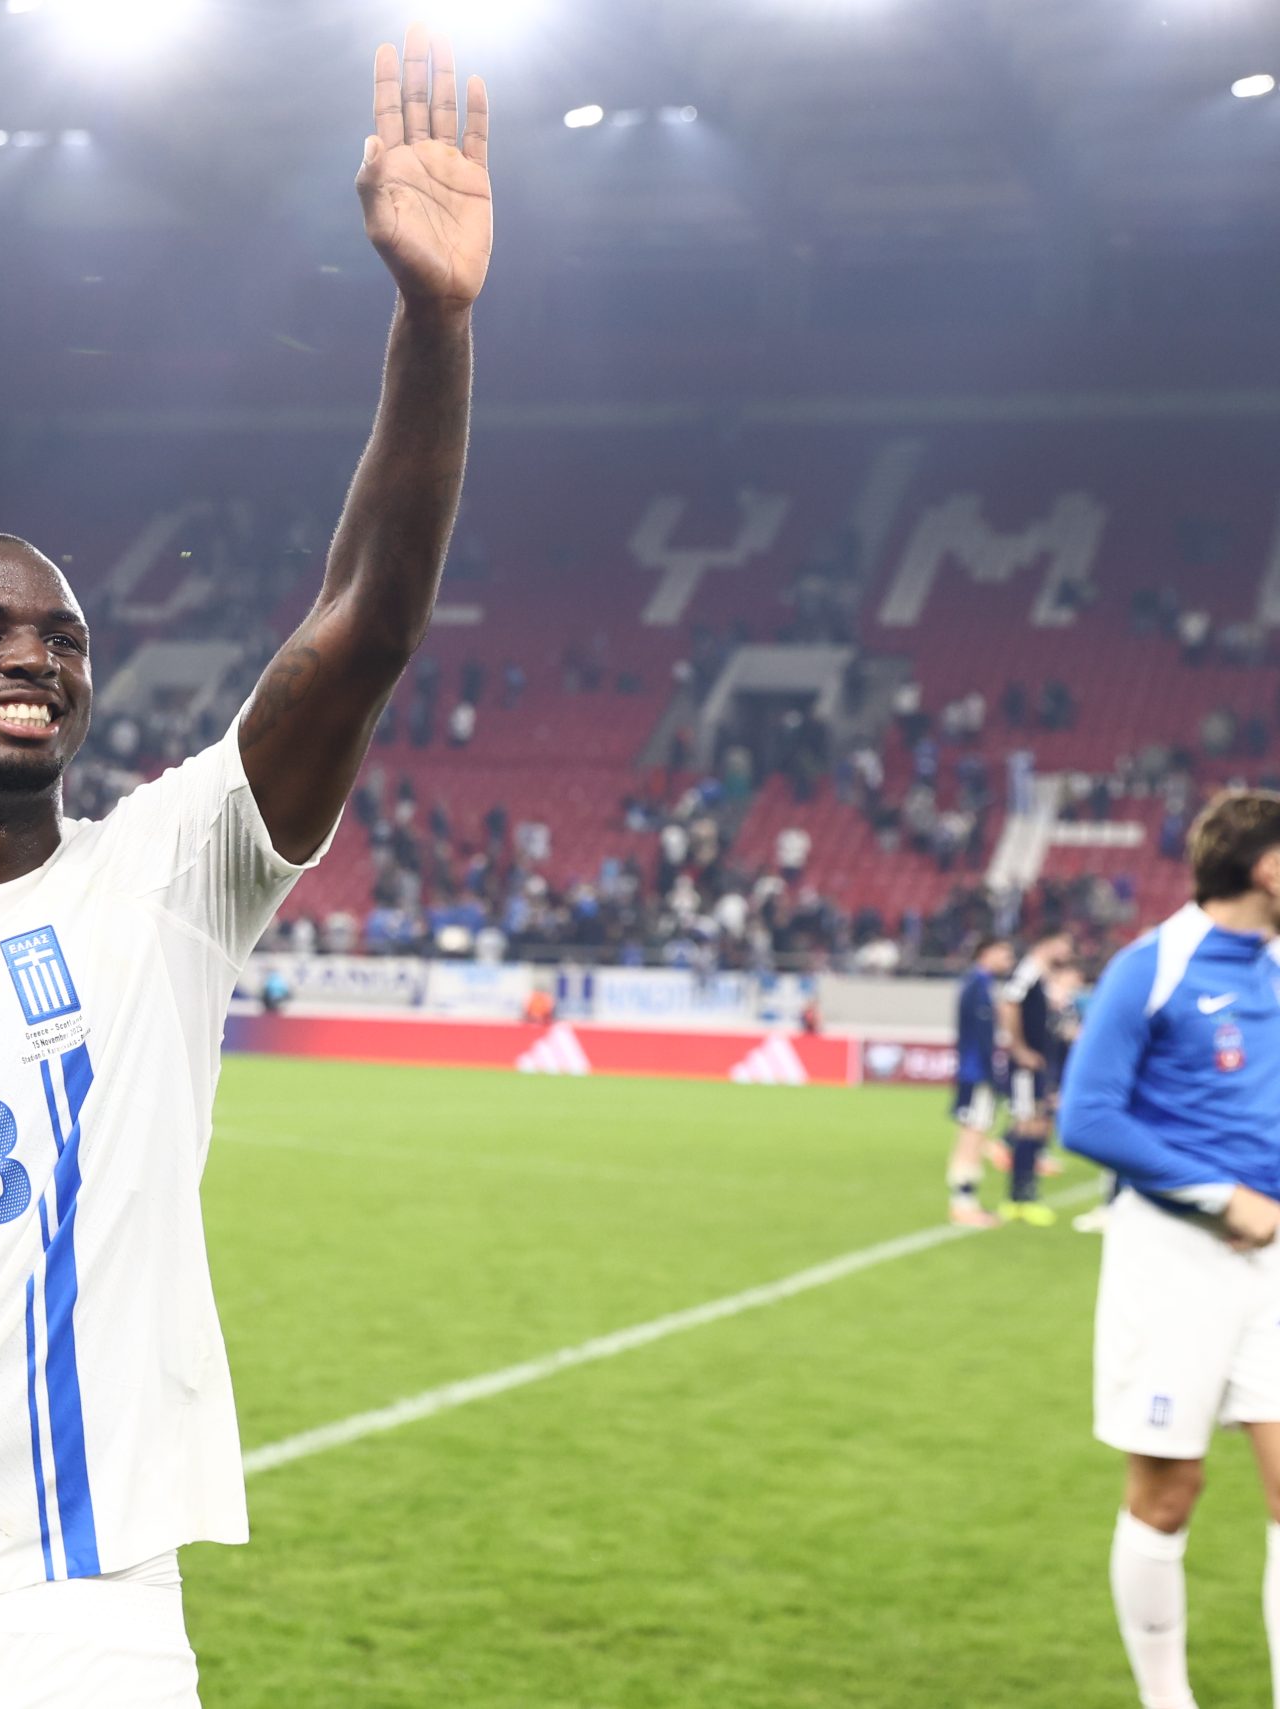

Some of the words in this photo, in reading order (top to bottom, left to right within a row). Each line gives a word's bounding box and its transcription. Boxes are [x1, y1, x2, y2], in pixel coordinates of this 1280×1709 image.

[8, 933, 50, 954] ΕΛΛΑΣ
[25, 1028, 49, 1040] Greece
[54, 1014, 83, 1031] Scotland
[31, 1039, 41, 1049] 15
[40, 1033, 69, 1047] November
